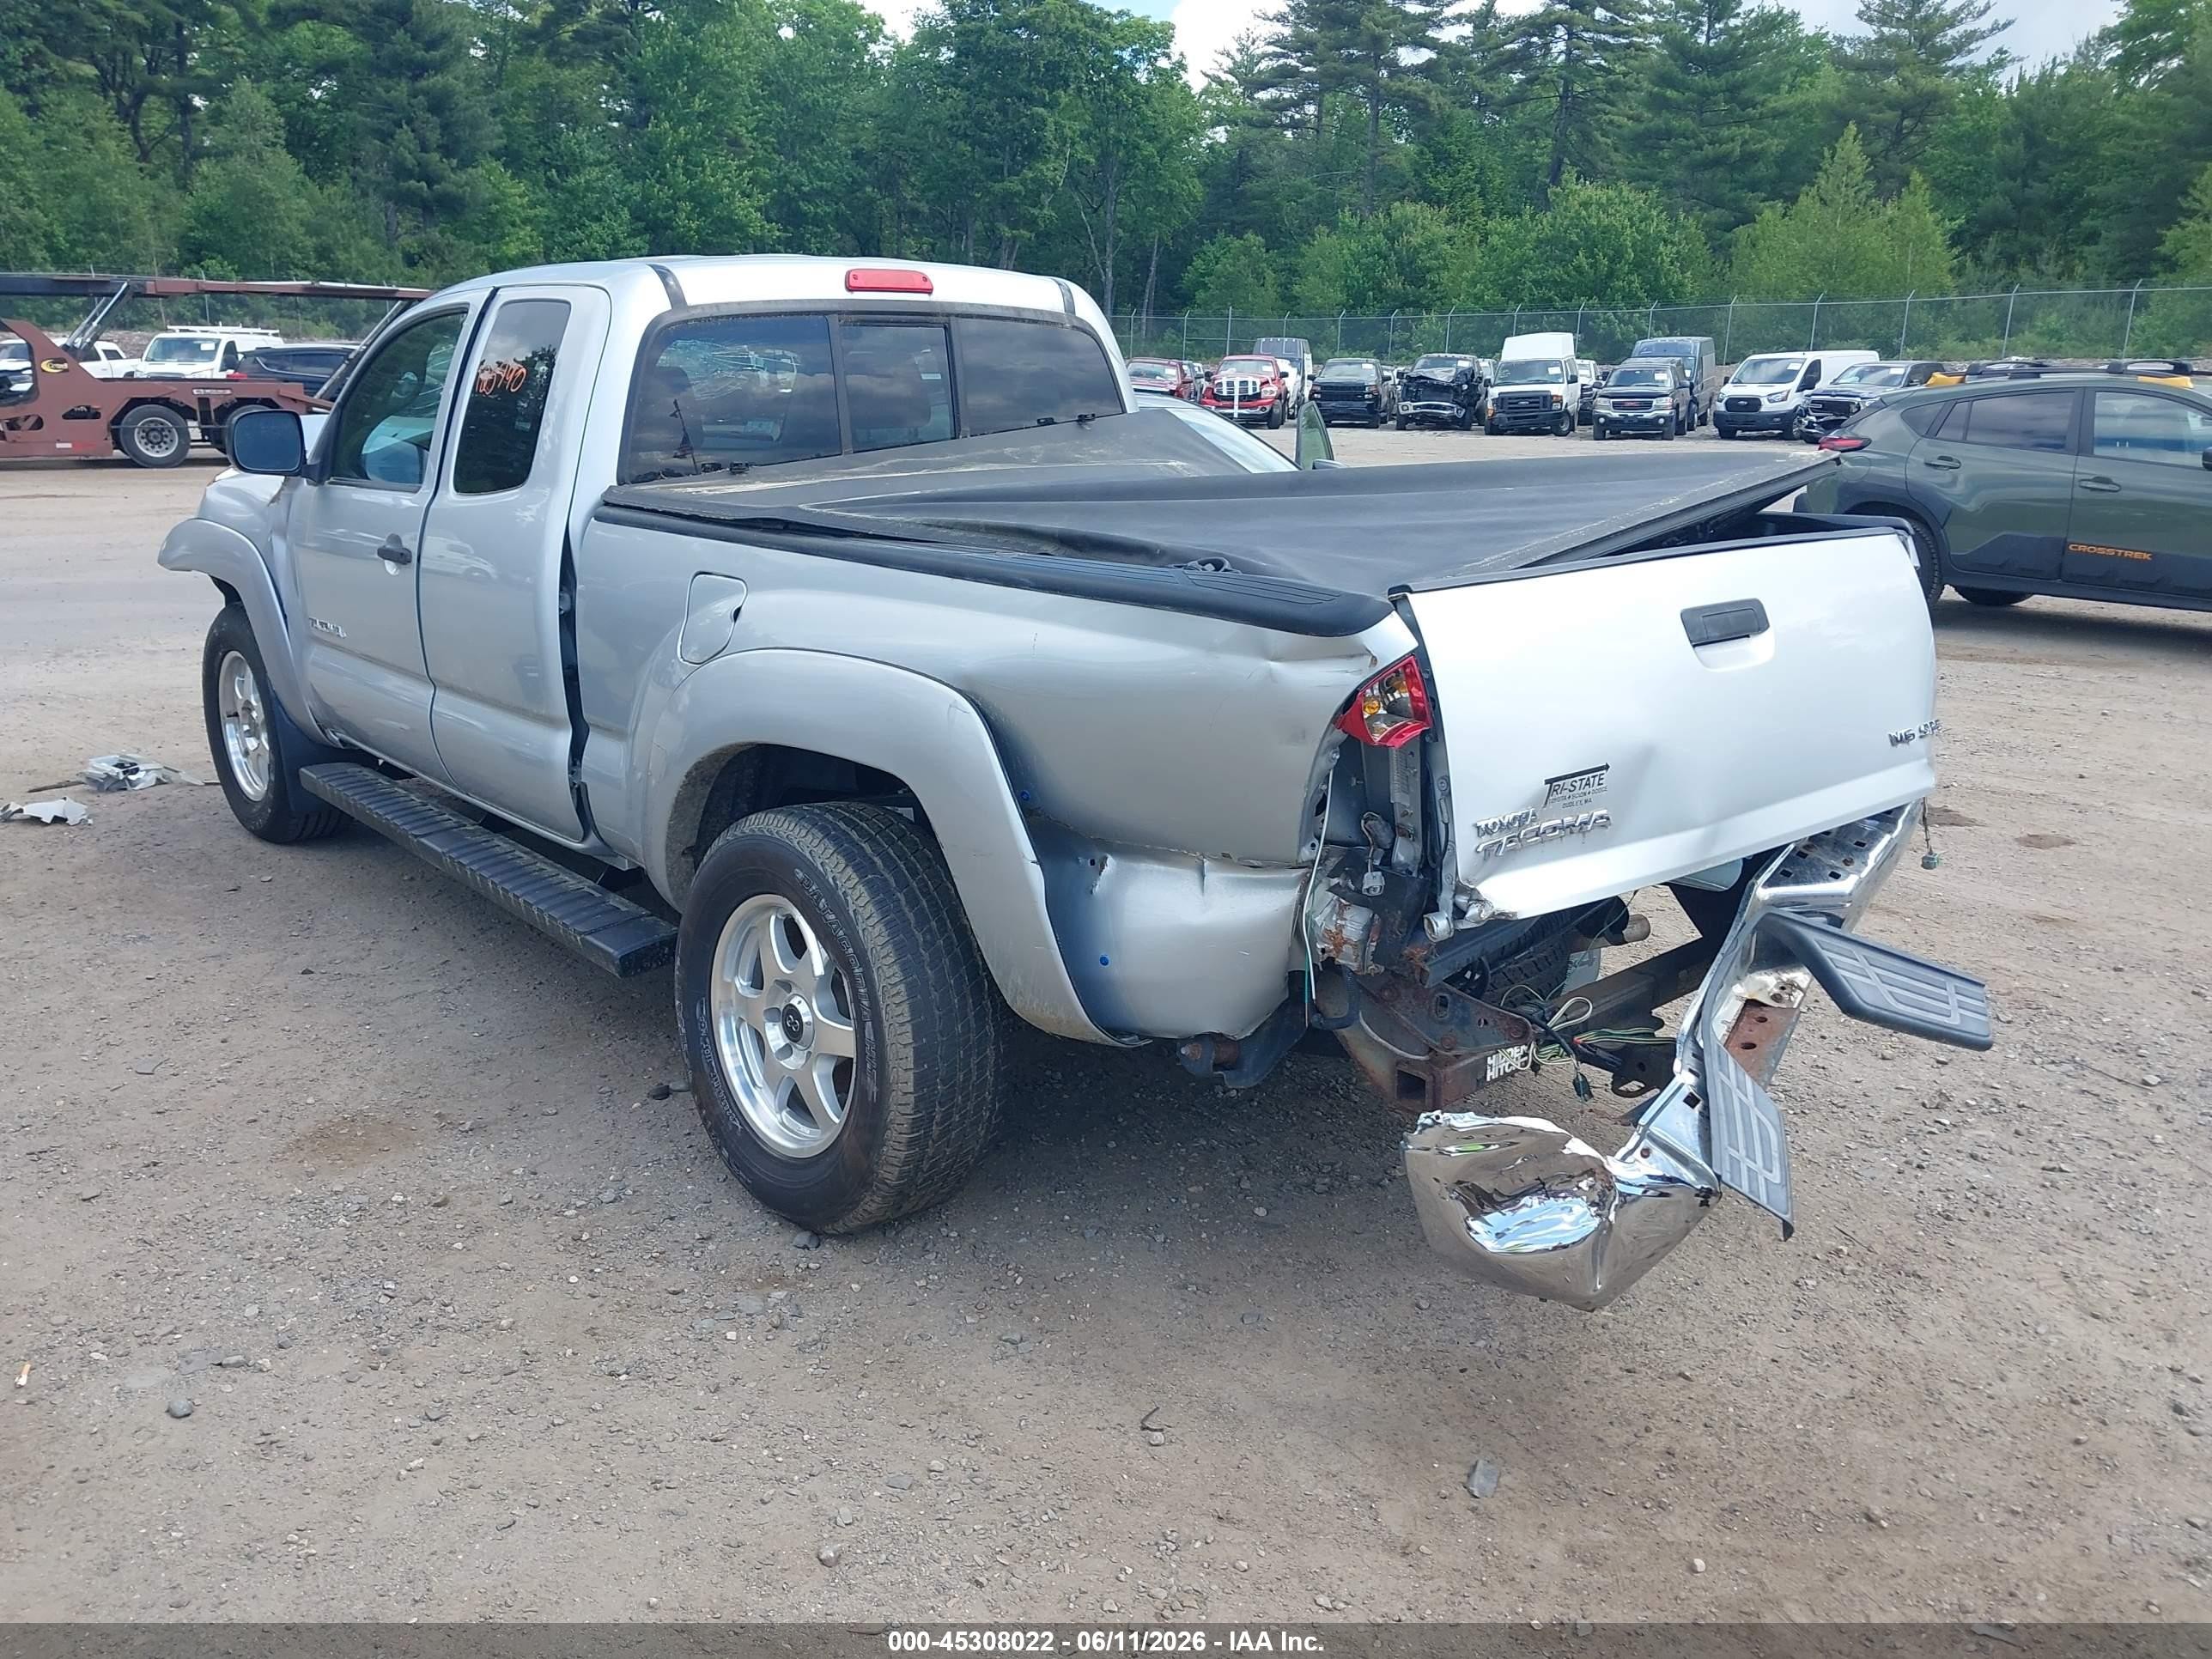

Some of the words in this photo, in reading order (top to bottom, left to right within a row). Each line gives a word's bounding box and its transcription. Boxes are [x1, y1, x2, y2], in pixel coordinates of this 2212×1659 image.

[2068, 543, 2153, 561] CROSSTREK
[1543, 766, 1607, 809] TRI-STATE
[1474, 808, 1537, 837] TOYOTA
[1475, 810, 1611, 860] TACOMA
